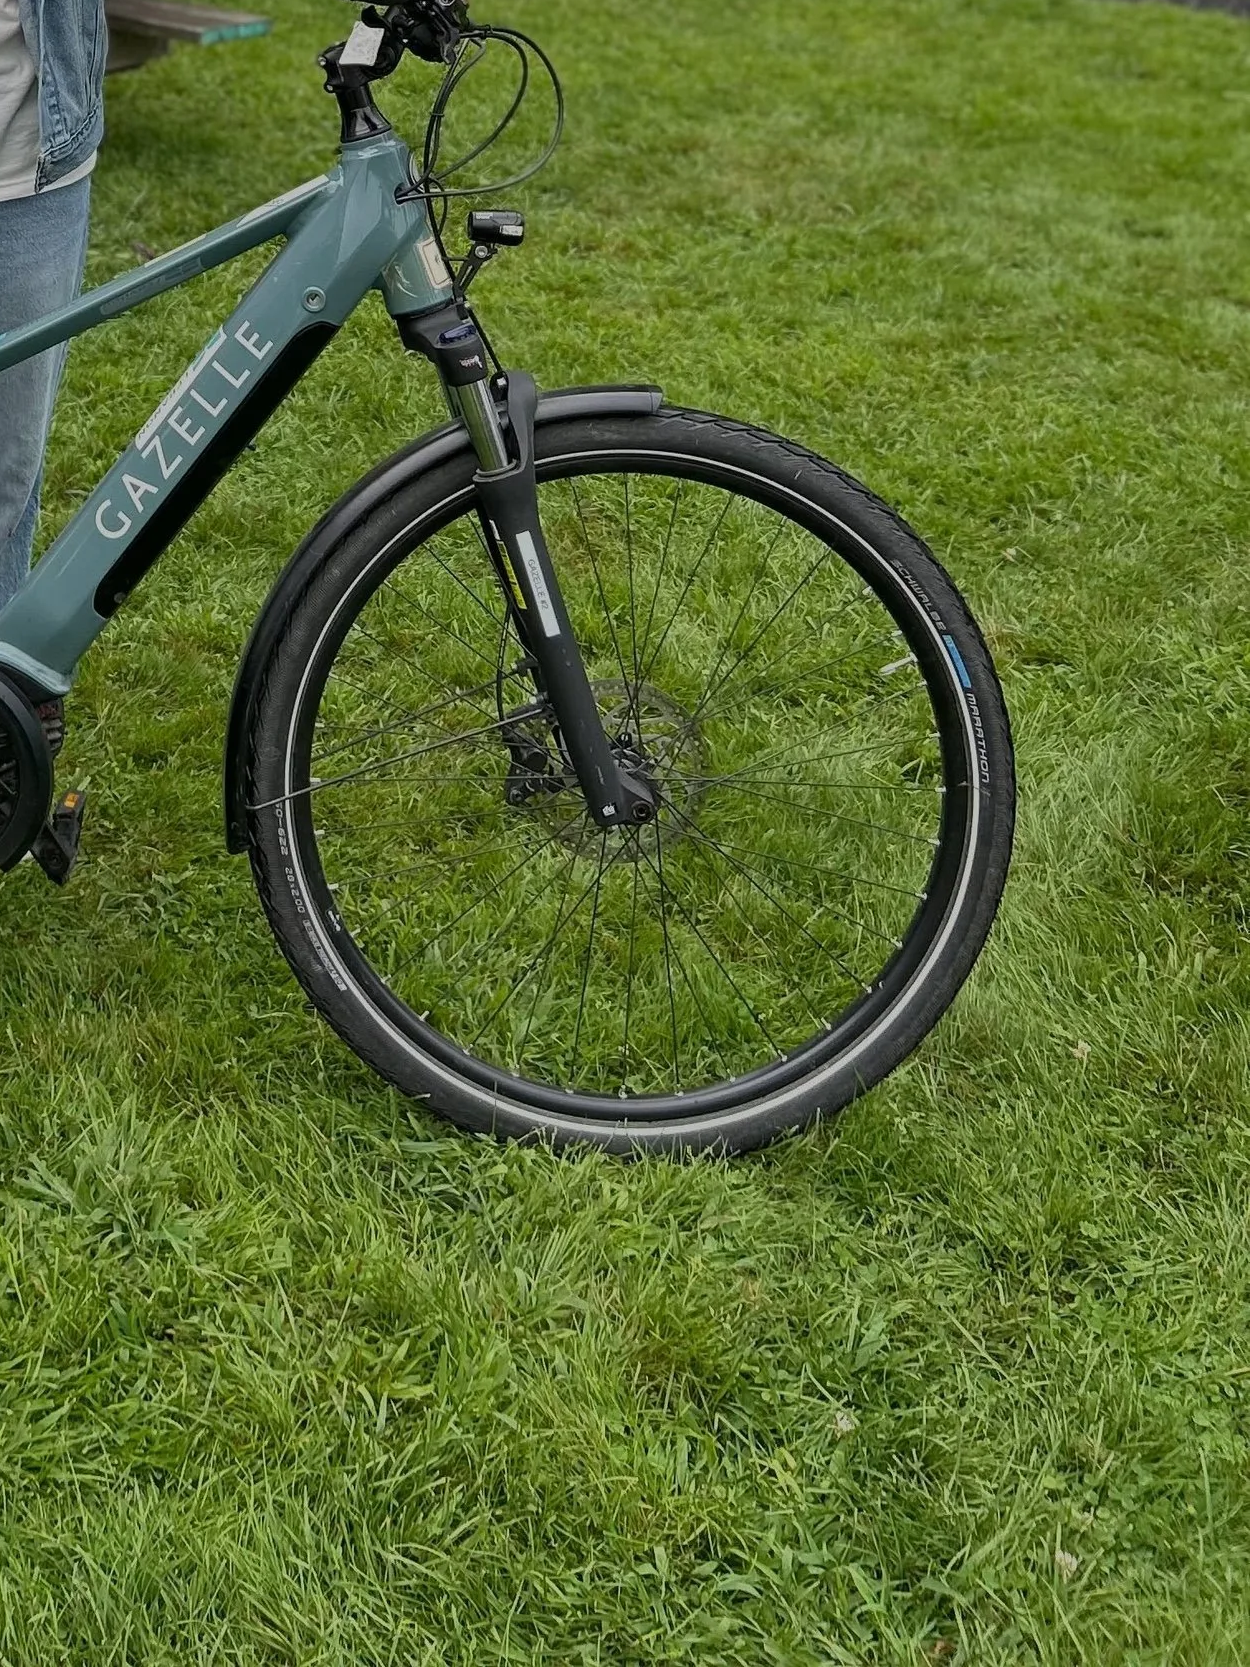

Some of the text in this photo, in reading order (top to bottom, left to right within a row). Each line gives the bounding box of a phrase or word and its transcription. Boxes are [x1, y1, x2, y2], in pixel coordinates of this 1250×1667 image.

[95, 319, 274, 539] GAZELLE
[528, 559, 546, 598] GAZELLE
[890, 559, 947, 631] SCHWALBE
[966, 693, 990, 784] MARATHON
